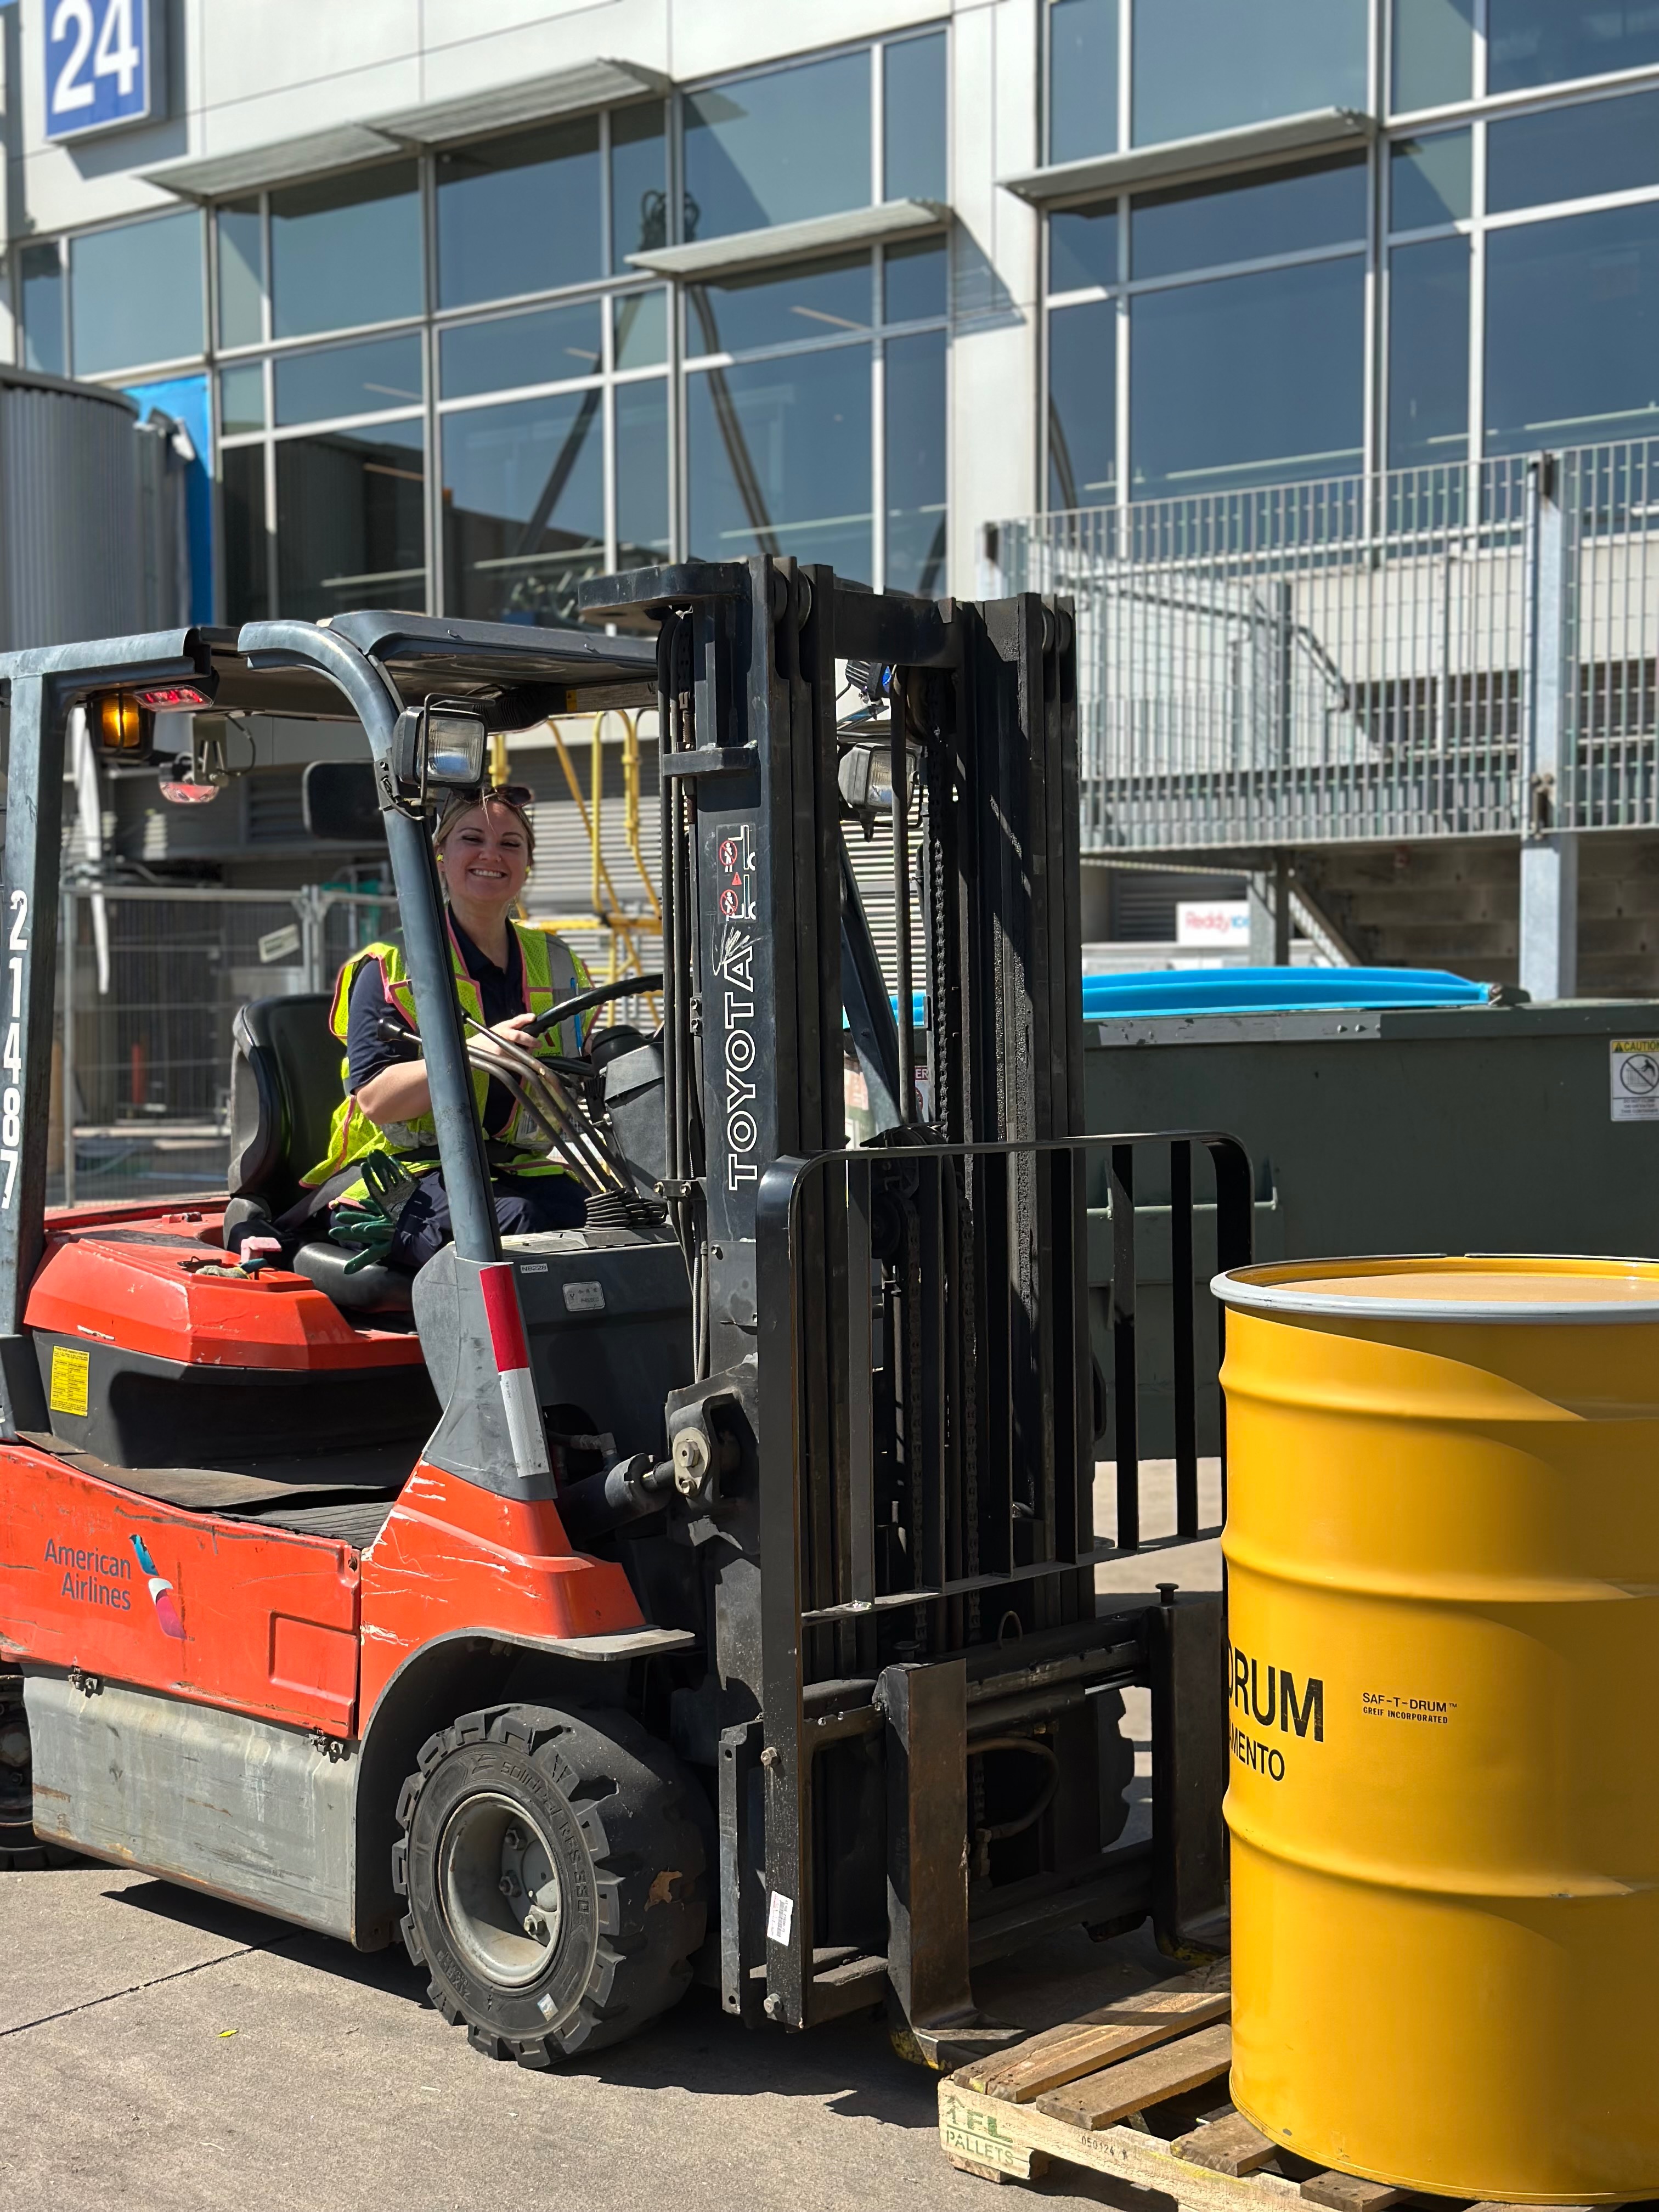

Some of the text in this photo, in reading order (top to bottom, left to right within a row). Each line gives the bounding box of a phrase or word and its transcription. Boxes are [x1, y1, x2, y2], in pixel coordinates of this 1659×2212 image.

[51, 0, 139, 114] 24
[1, 890, 27, 1209] 21487
[724, 945, 758, 1190] TOYOTA
[44, 1538, 131, 1580] American
[61, 1571, 131, 1611] Airlines
[1363, 1706, 1448, 1724] GREIF INCORPORATED
[946, 2130, 1014, 2165] PALLETS
